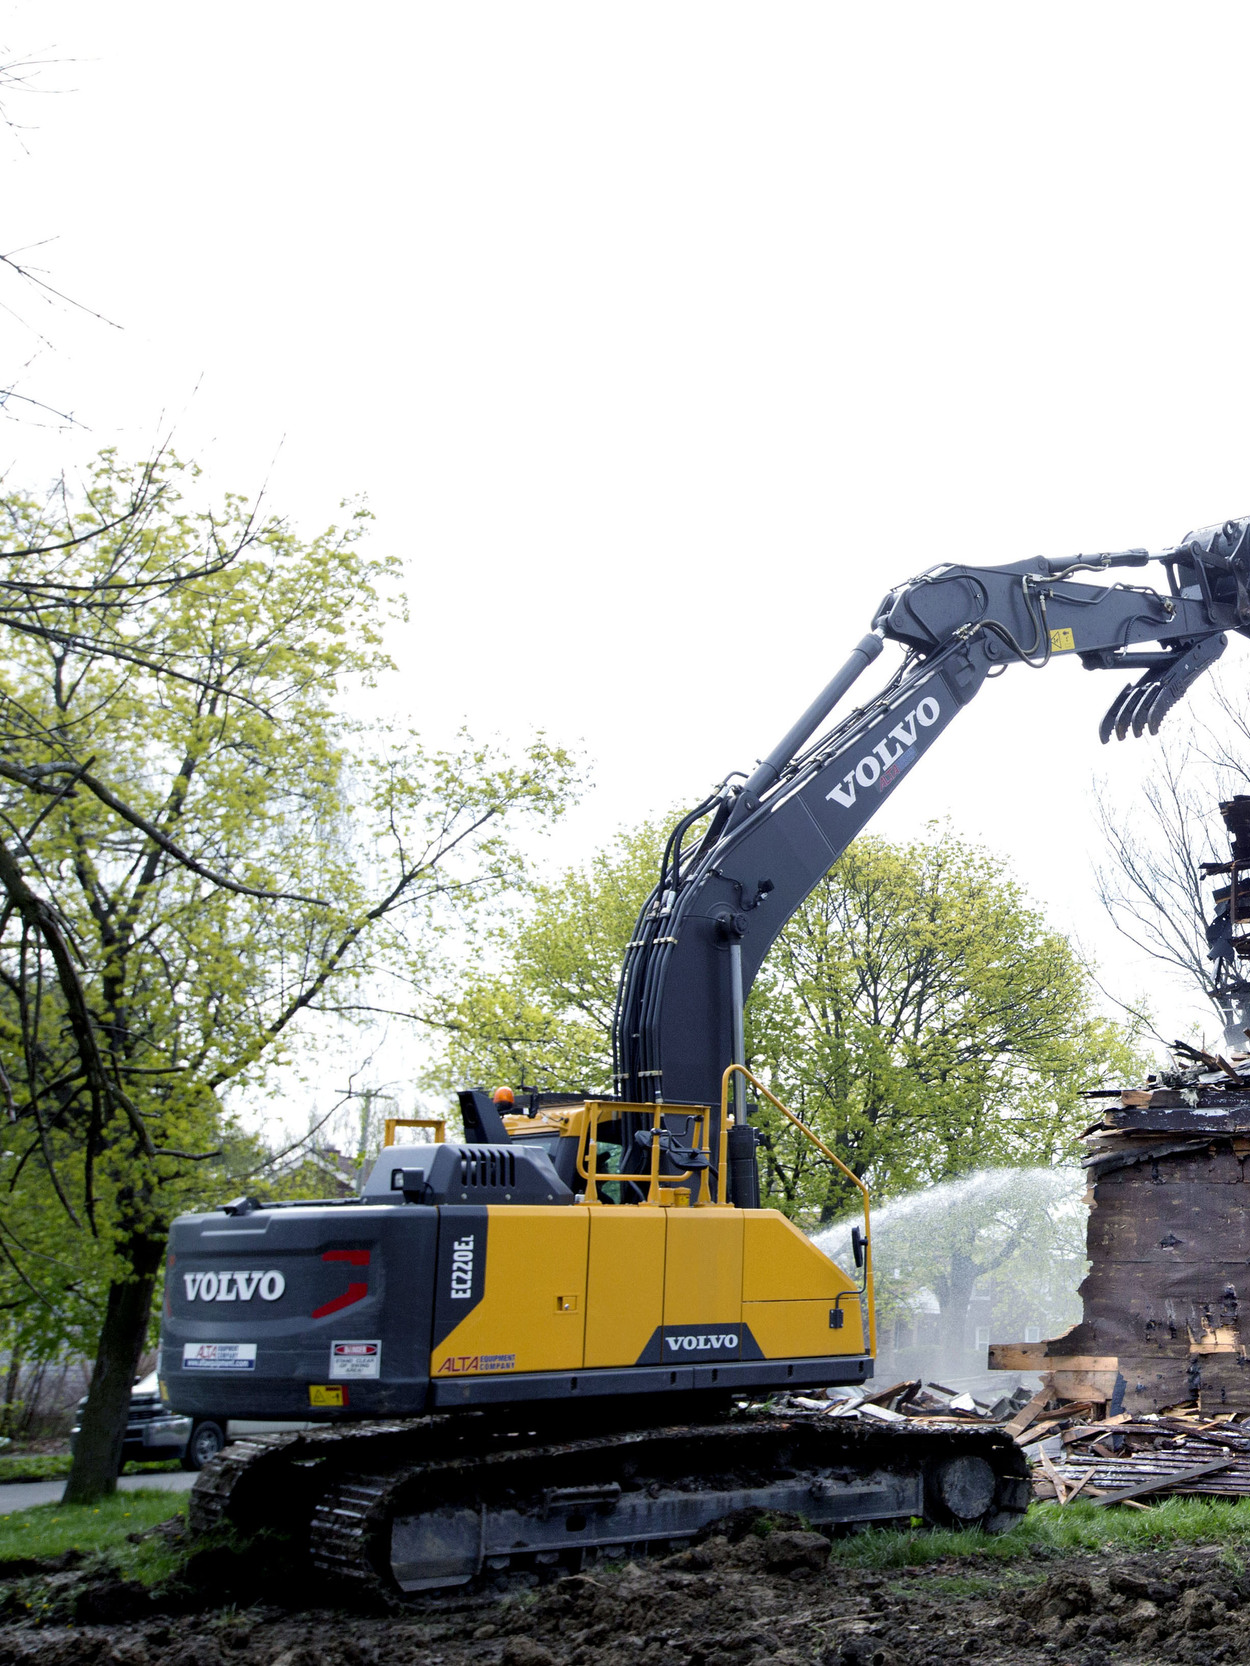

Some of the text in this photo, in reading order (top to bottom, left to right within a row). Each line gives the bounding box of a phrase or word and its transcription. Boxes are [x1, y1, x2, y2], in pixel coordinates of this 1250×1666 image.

[825, 697, 940, 808] VOLVO
[880, 764, 900, 791] ALTA
[183, 1270, 285, 1301] VOLVO
[665, 1334, 738, 1350] VOLVO
[197, 1345, 217, 1359] ALTA
[480, 1354, 515, 1362] EQUIPMENT
[438, 1356, 479, 1373] ALTA
[480, 1362, 514, 1371] COMPANY
